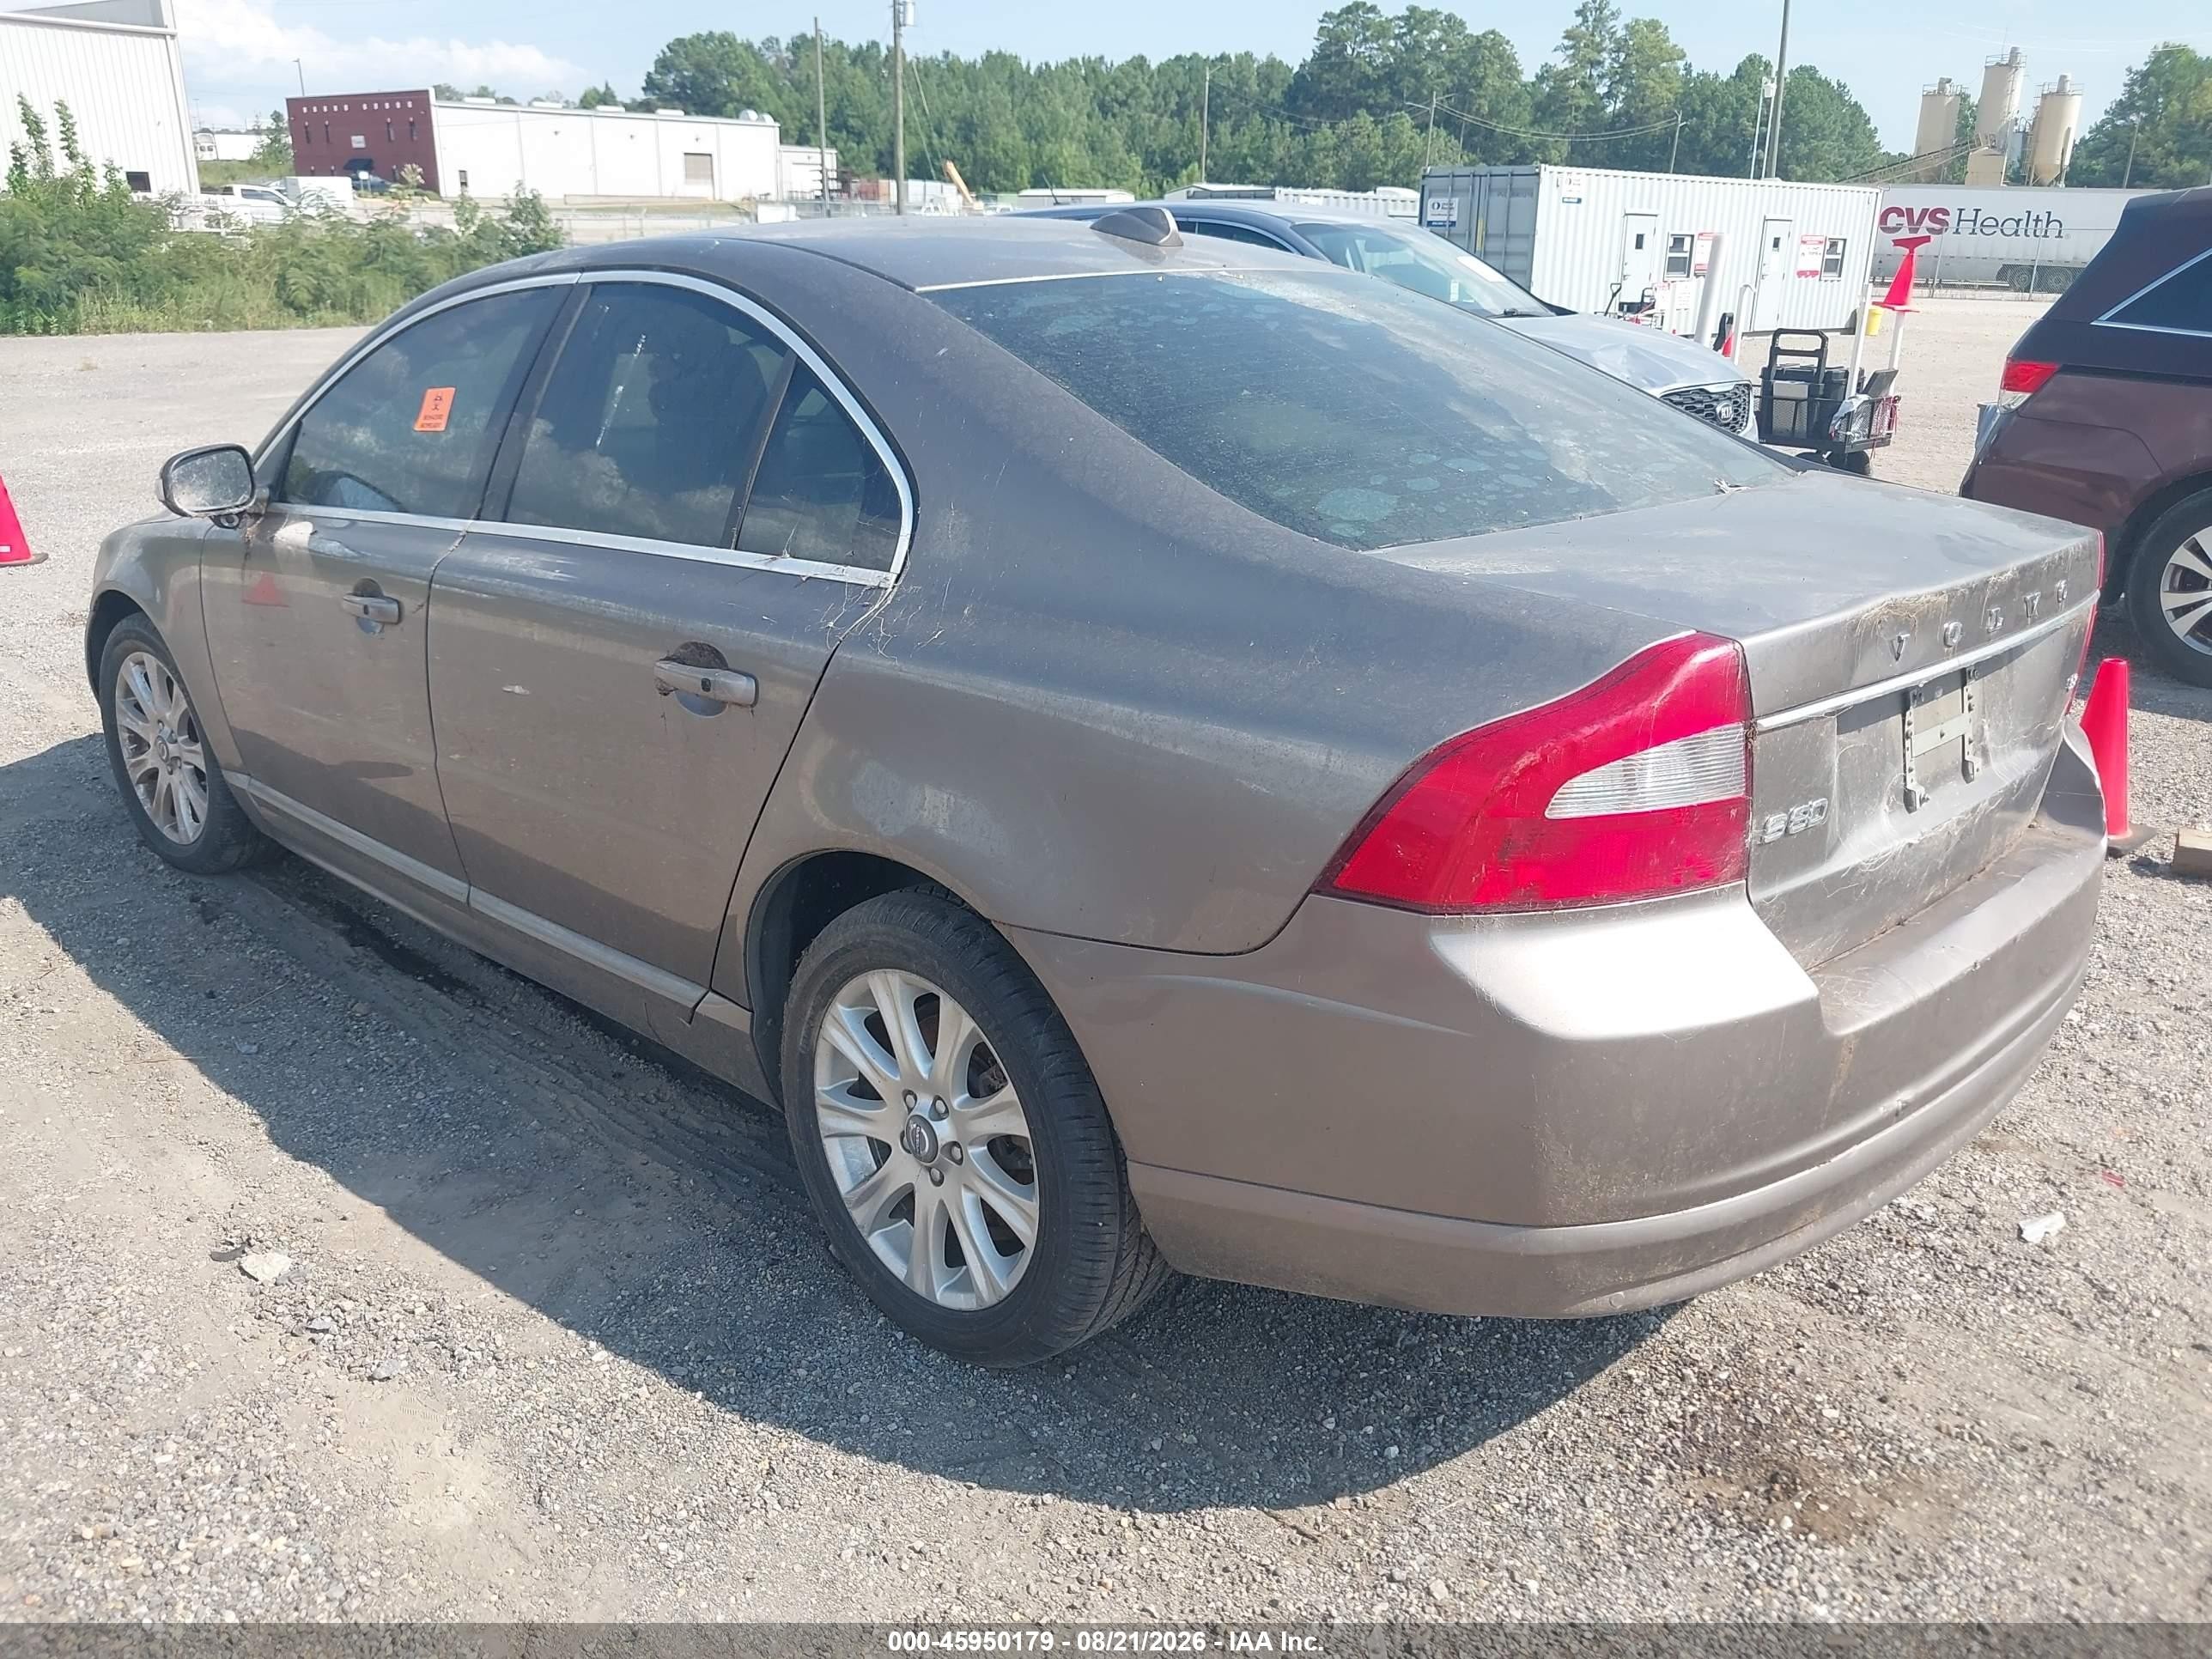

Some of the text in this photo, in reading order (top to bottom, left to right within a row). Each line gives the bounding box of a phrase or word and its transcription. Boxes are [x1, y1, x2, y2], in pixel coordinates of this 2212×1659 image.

[1879, 206, 2063, 239] CVS Health
[1890, 579, 2069, 662] VOLVO
[1759, 798, 1828, 844] S80
